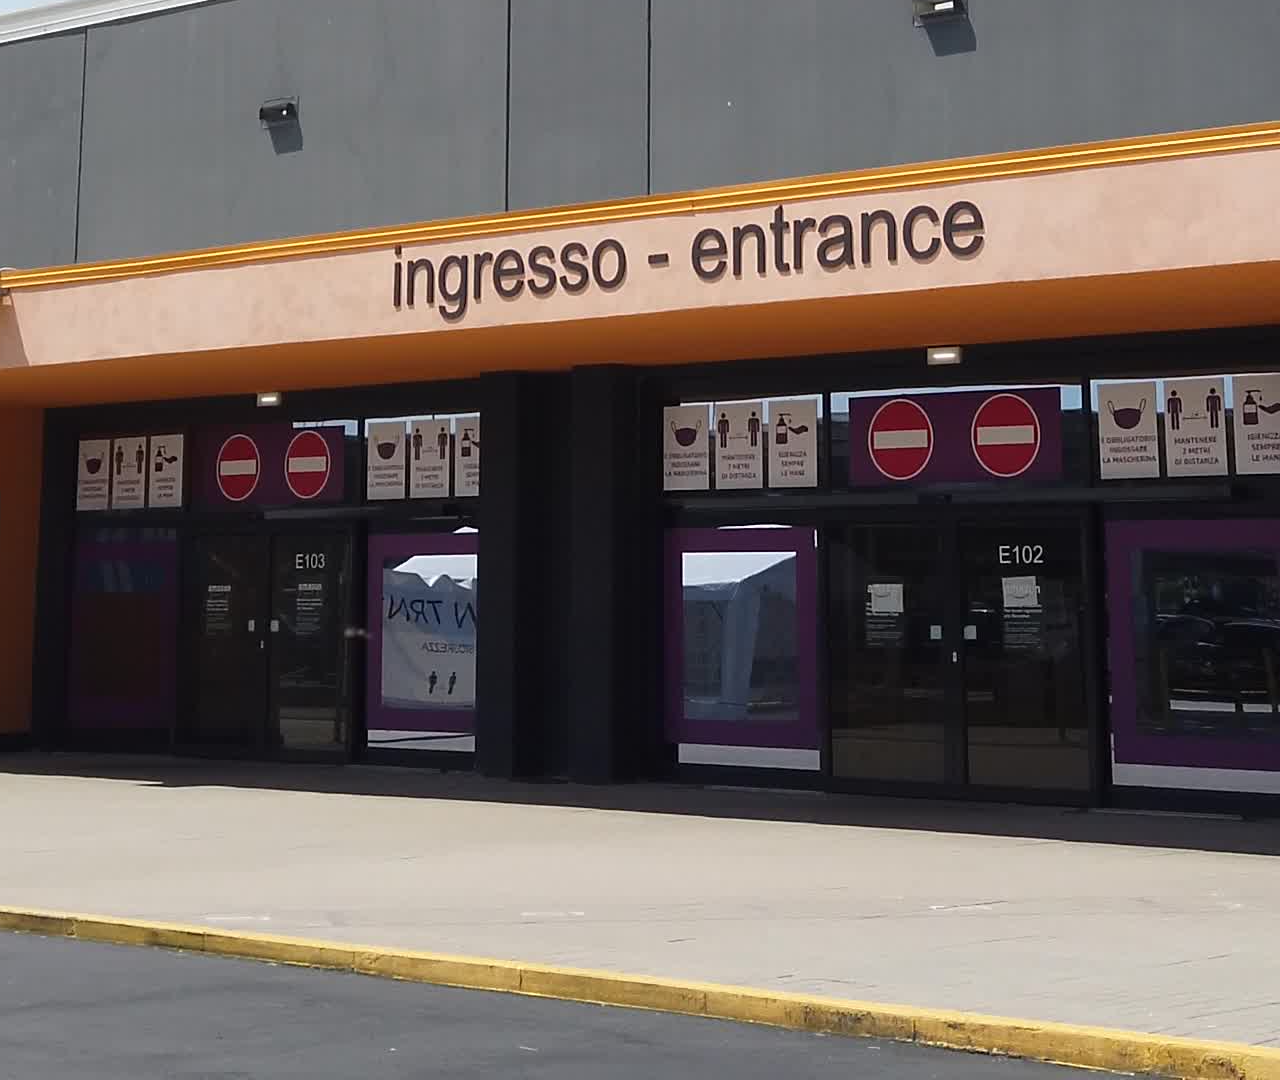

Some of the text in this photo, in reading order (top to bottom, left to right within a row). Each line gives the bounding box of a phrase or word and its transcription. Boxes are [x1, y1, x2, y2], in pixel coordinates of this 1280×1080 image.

[393, 245, 627, 321] ingresso
[691, 200, 984, 281] entrance
[1251, 443, 1280, 451] SEMPRE
[296, 553, 325, 569] E103
[999, 545, 1044, 564] E102
